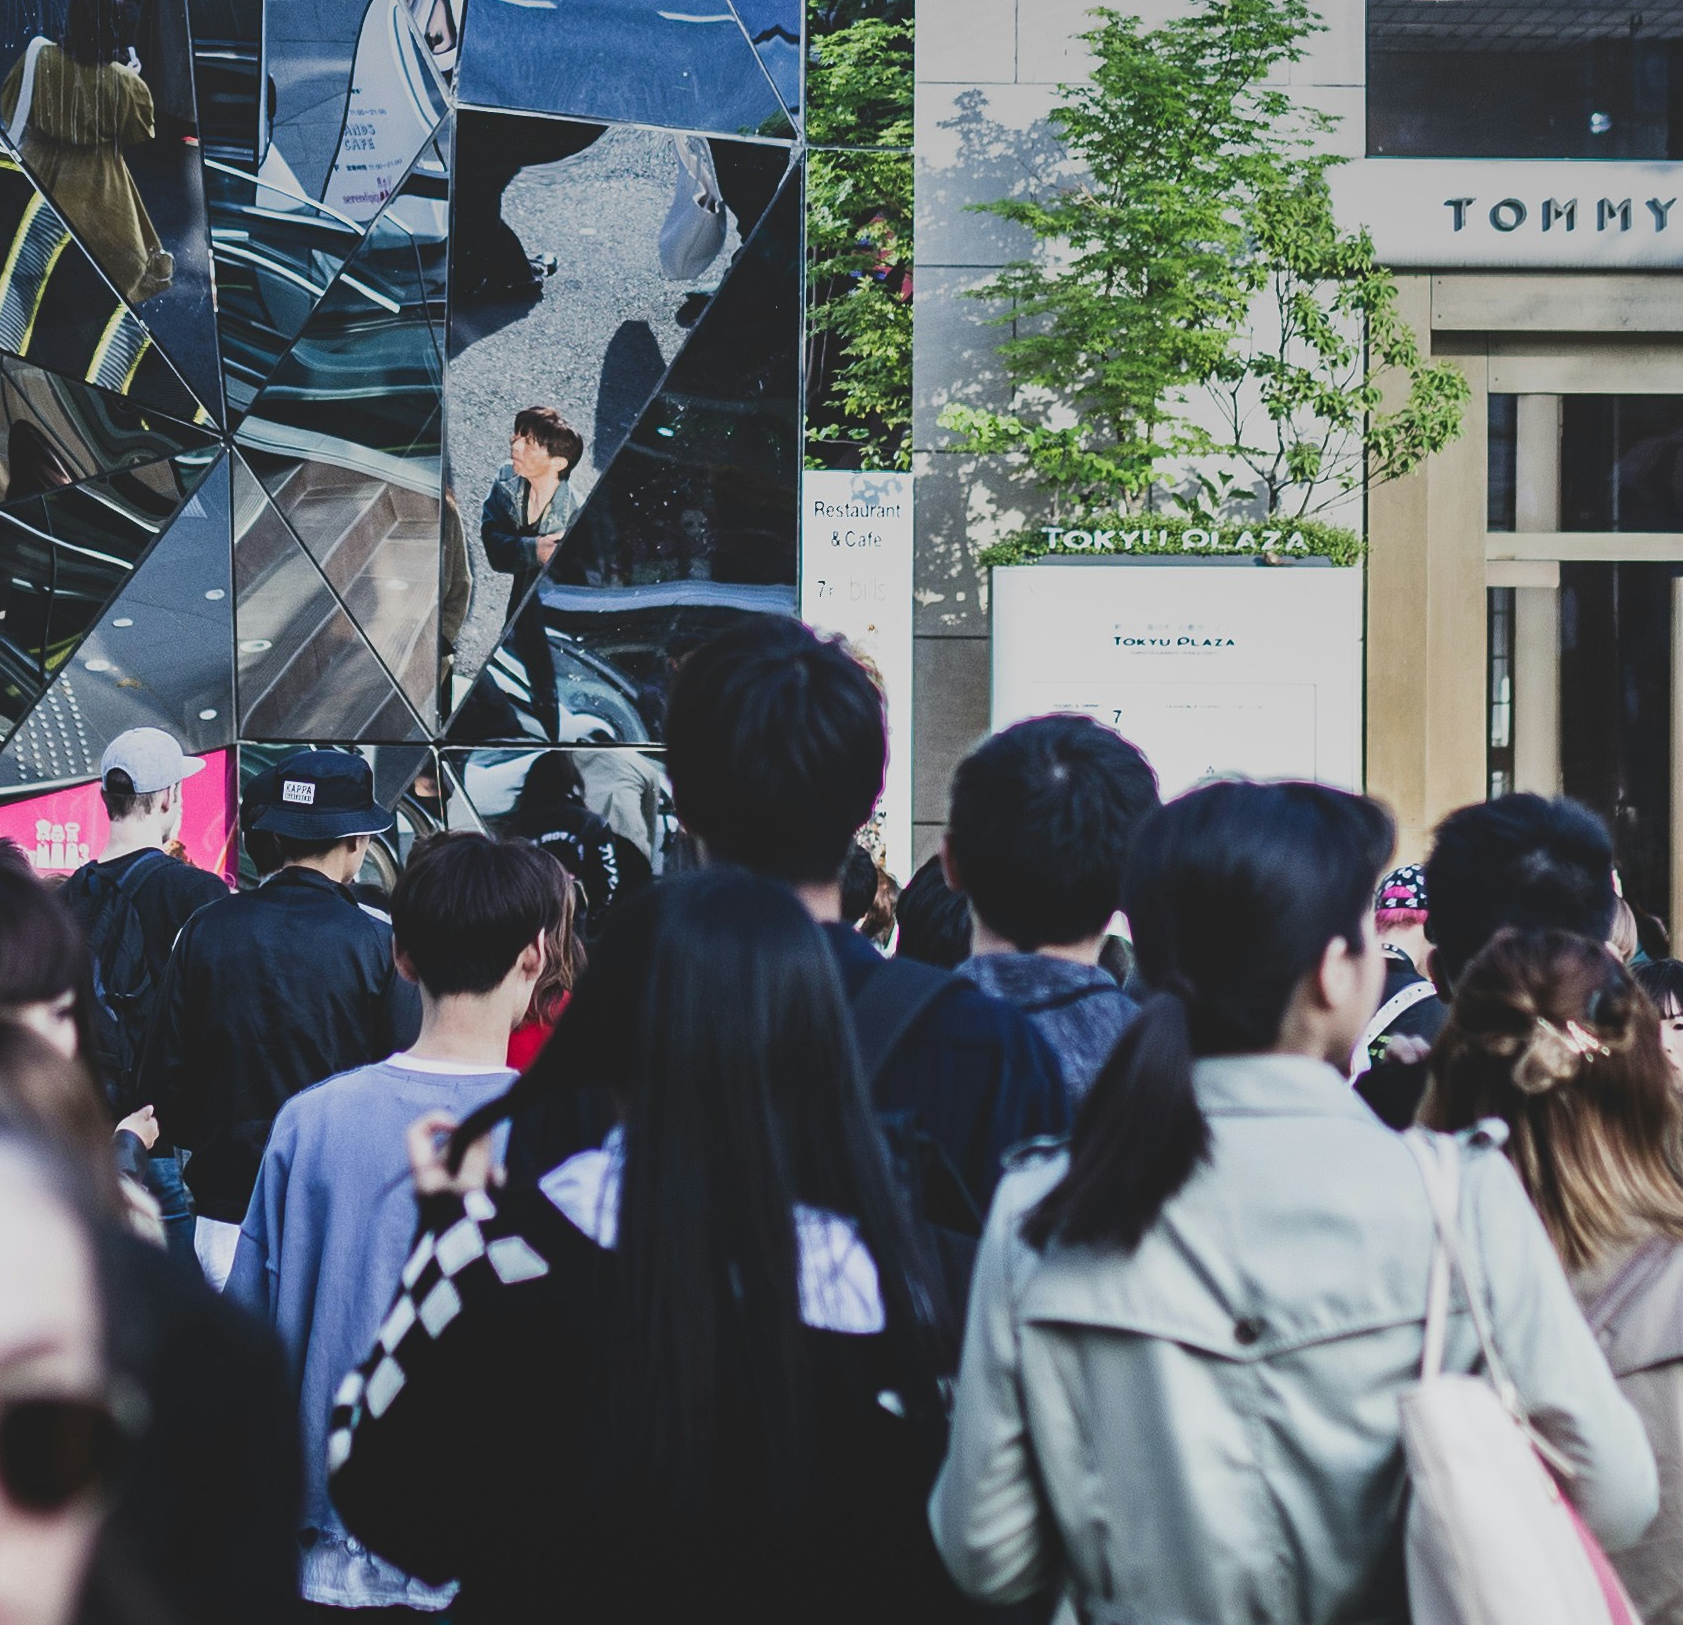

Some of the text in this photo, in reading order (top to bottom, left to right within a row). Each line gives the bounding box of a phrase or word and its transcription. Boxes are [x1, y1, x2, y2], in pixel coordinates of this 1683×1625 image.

[1443, 196, 1678, 233] TOMMY
[814, 500, 901, 518] Restaurant
[830, 530, 883, 547] & Cafe
[1041, 526, 1309, 551] TOKYU PLAZA
[1113, 636, 1235, 647] TOKYU PLAZA
[1112, 710, 1122, 724] 7
[286, 783, 312, 795] KAPPA
